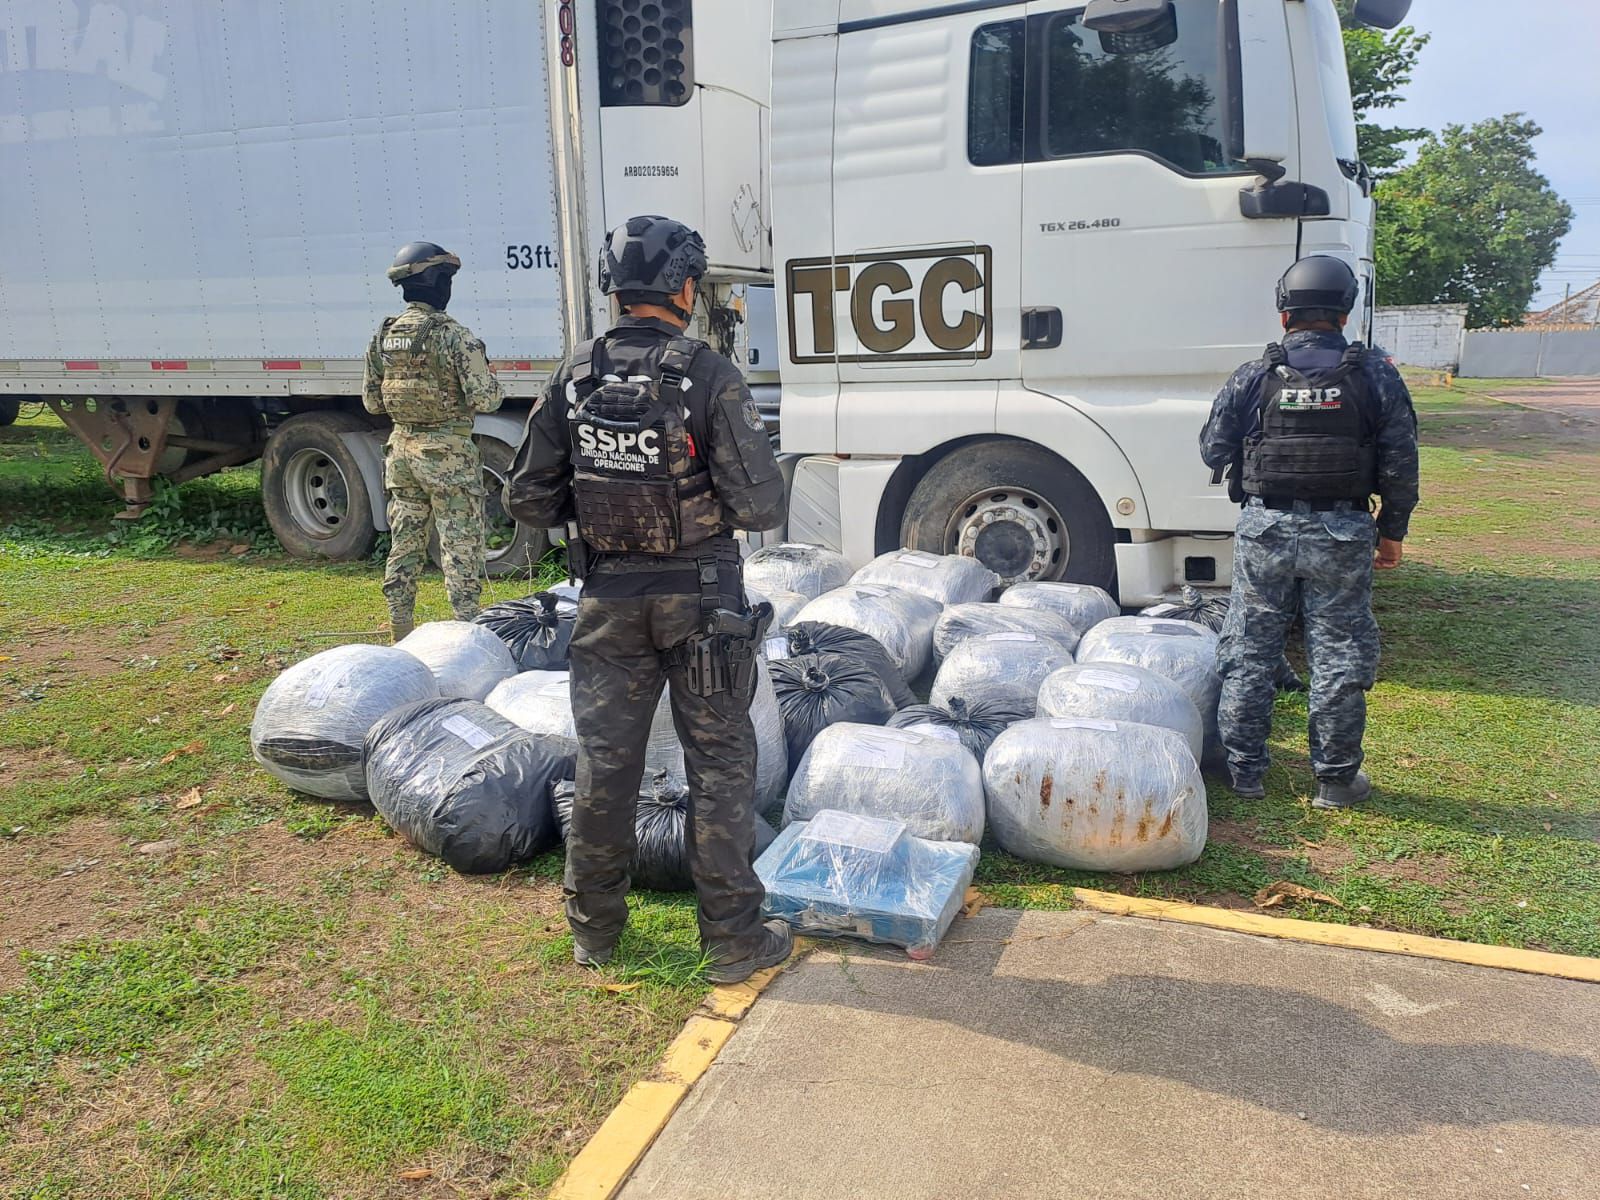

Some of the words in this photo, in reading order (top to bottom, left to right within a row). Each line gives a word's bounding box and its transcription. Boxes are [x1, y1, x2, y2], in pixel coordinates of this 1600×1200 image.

[559, 0, 574, 67] 08
[1040, 222, 1066, 232] TGX
[1068, 218, 1120, 230] 26.480
[792, 256, 985, 353] TGC
[383, 338, 426, 350] ARIN
[1280, 387, 1341, 402] FRIP
[577, 424, 660, 456] SSPC
[581, 448, 608, 459] UNIDAD
[609, 451, 647, 463] NACIONAL
[648, 455, 659, 464] DE
[594, 458, 645, 472] OPERACIONES
